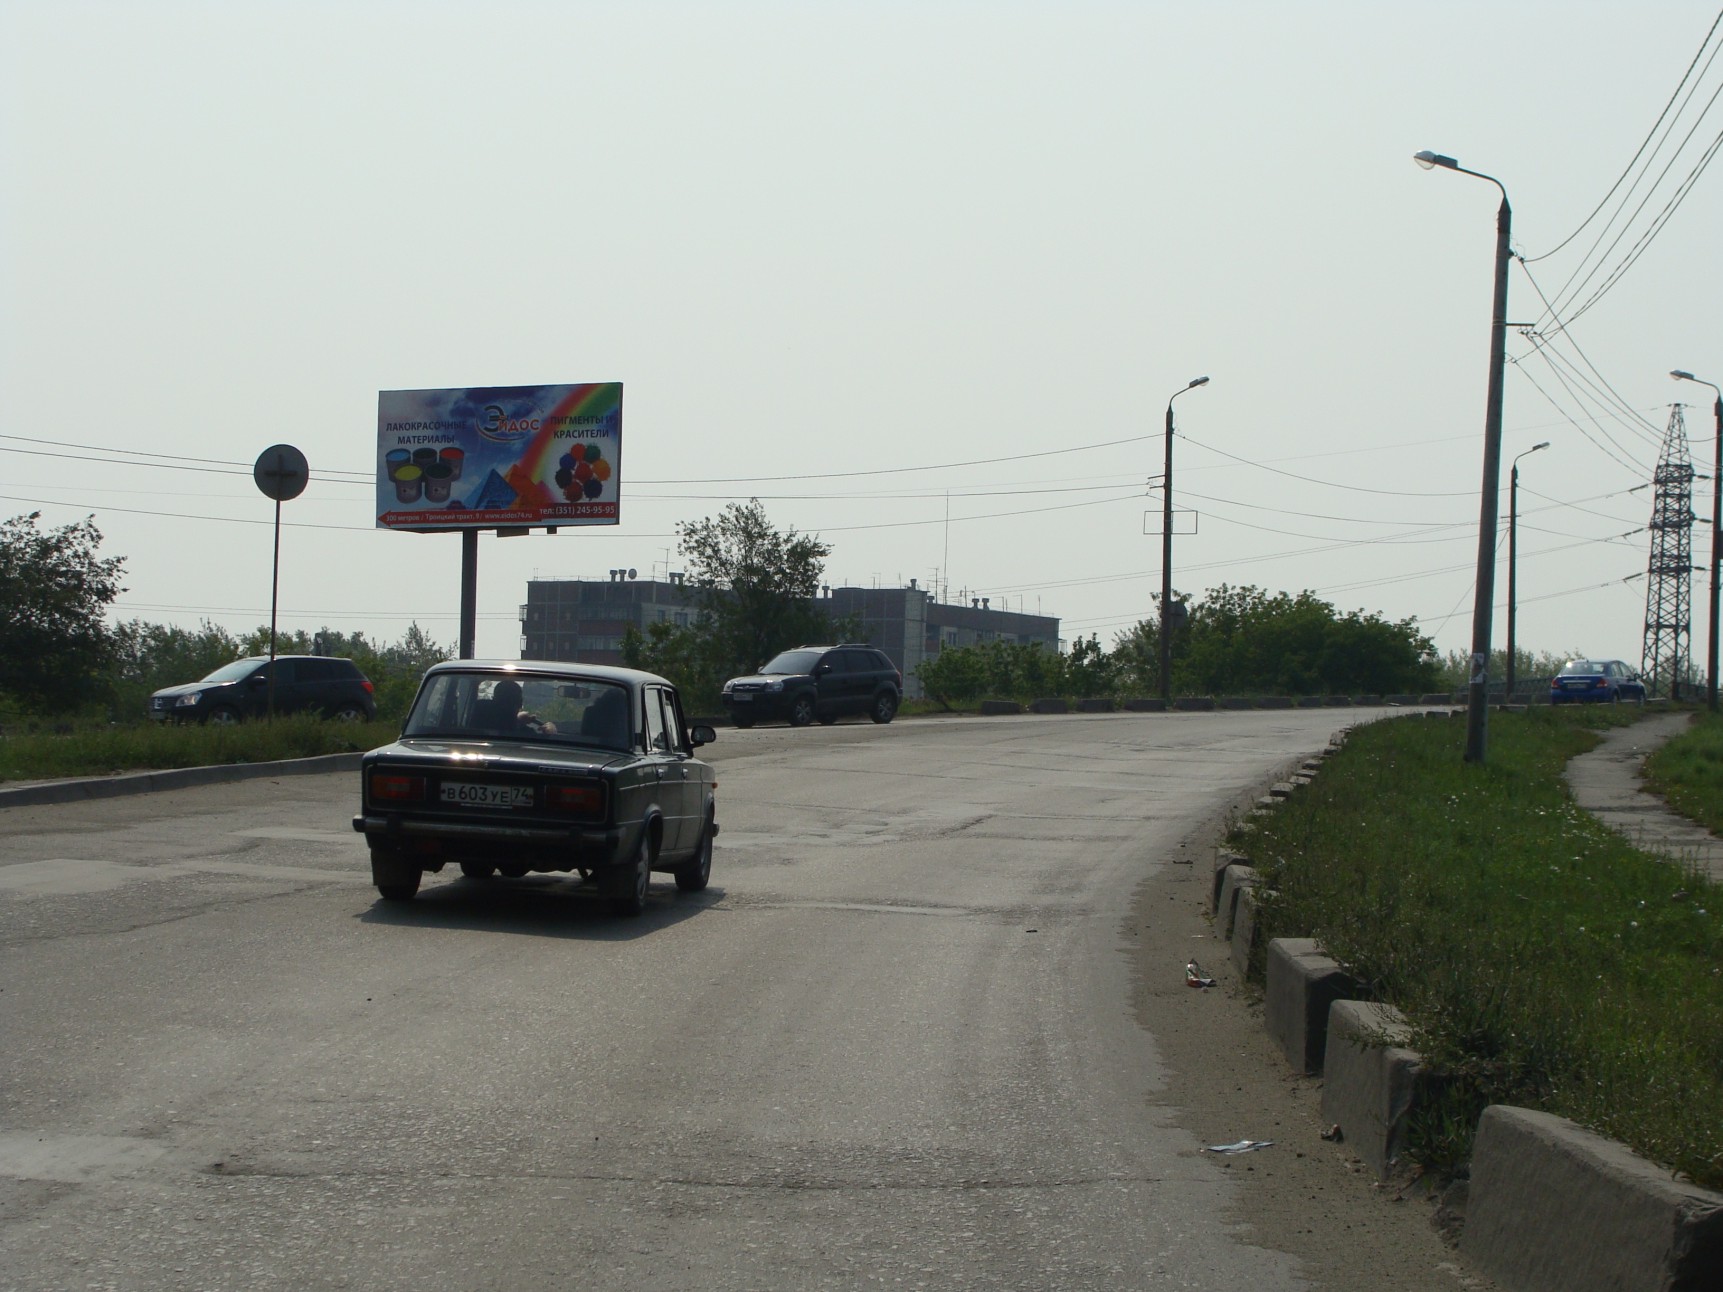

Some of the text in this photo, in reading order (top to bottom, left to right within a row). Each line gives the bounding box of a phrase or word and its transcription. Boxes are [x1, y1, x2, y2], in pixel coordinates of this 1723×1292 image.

[386, 420, 467, 431] ЛАКОКРАСОЧНЫЕ
[550, 415, 604, 425] ПИГМЕНТЫ
[397, 434, 455, 445] МАТЕРИАЛЫ
[553, 429, 609, 439] КРАСИТЕЛИ
[555, 506, 575, 515] (351)
[576, 504, 615, 514] 245-95-95
